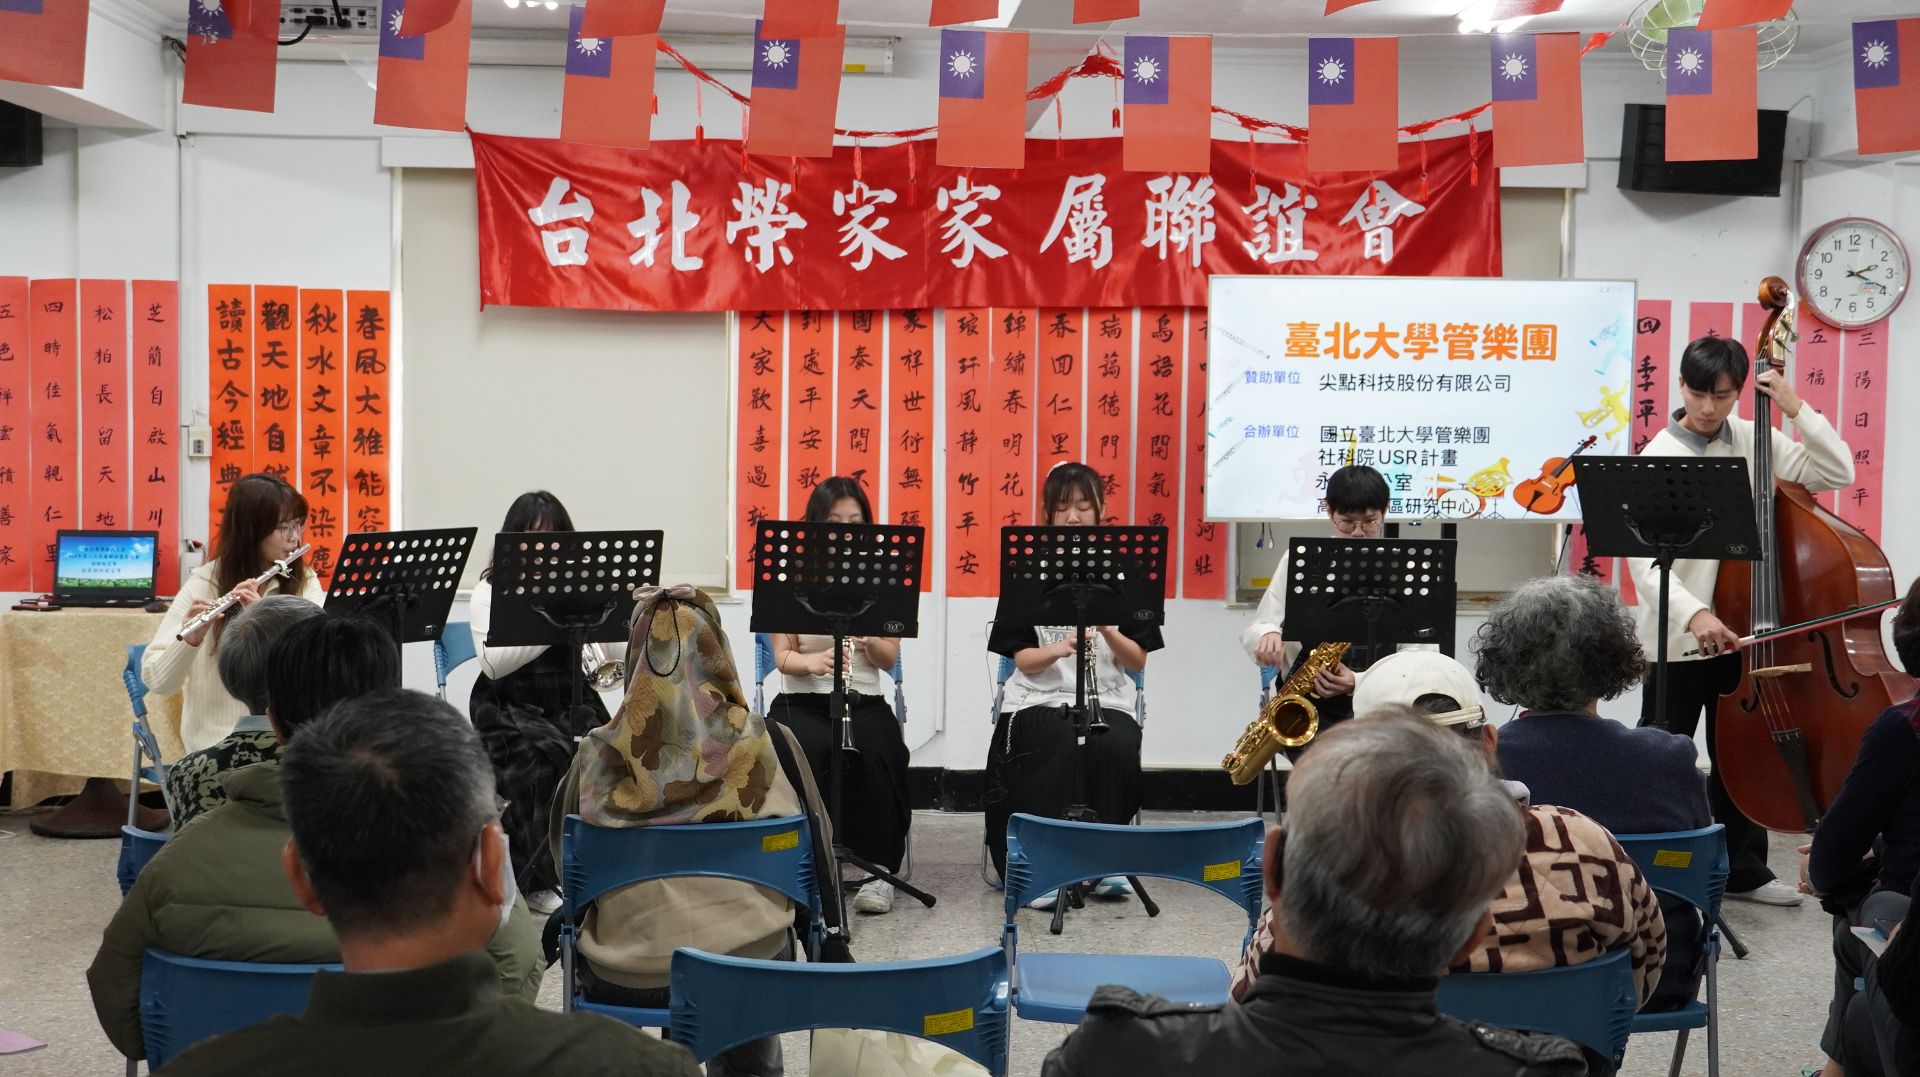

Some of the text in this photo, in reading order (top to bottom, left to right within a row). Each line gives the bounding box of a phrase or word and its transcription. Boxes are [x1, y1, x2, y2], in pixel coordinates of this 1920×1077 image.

[527, 172, 1427, 273] 台北榮家家屬聯誼會
[1834, 239, 1842, 251] 11
[1849, 234, 1861, 246] 12
[1821, 252, 1833, 264] 10
[1880, 250, 1889, 262] 2
[1814, 268, 1823, 280] 9
[1885, 267, 1894, 279] 3
[1819, 286, 1828, 297] 8
[1878, 285, 1887, 296] 4
[1833, 297, 1842, 309] 7
[1848, 301, 1857, 313] 6
[1866, 297, 1875, 309] 5
[1284, 321, 1557, 361] 臺北大學管樂團
[1244, 370, 1301, 385] 贊助單位
[1319, 373, 1511, 392] 尖點科技股份有限公司
[216, 298, 250, 526] 讀古今經典
[747, 311, 776, 563] 大家歡喜過新
[1243, 424, 1299, 439] 合辦單位
[1320, 425, 1490, 444] 國立臺北大學管樂團
[1852, 332, 1876, 532] 三陽日照平
[305, 303, 339, 578] 秋水文章不染塵
